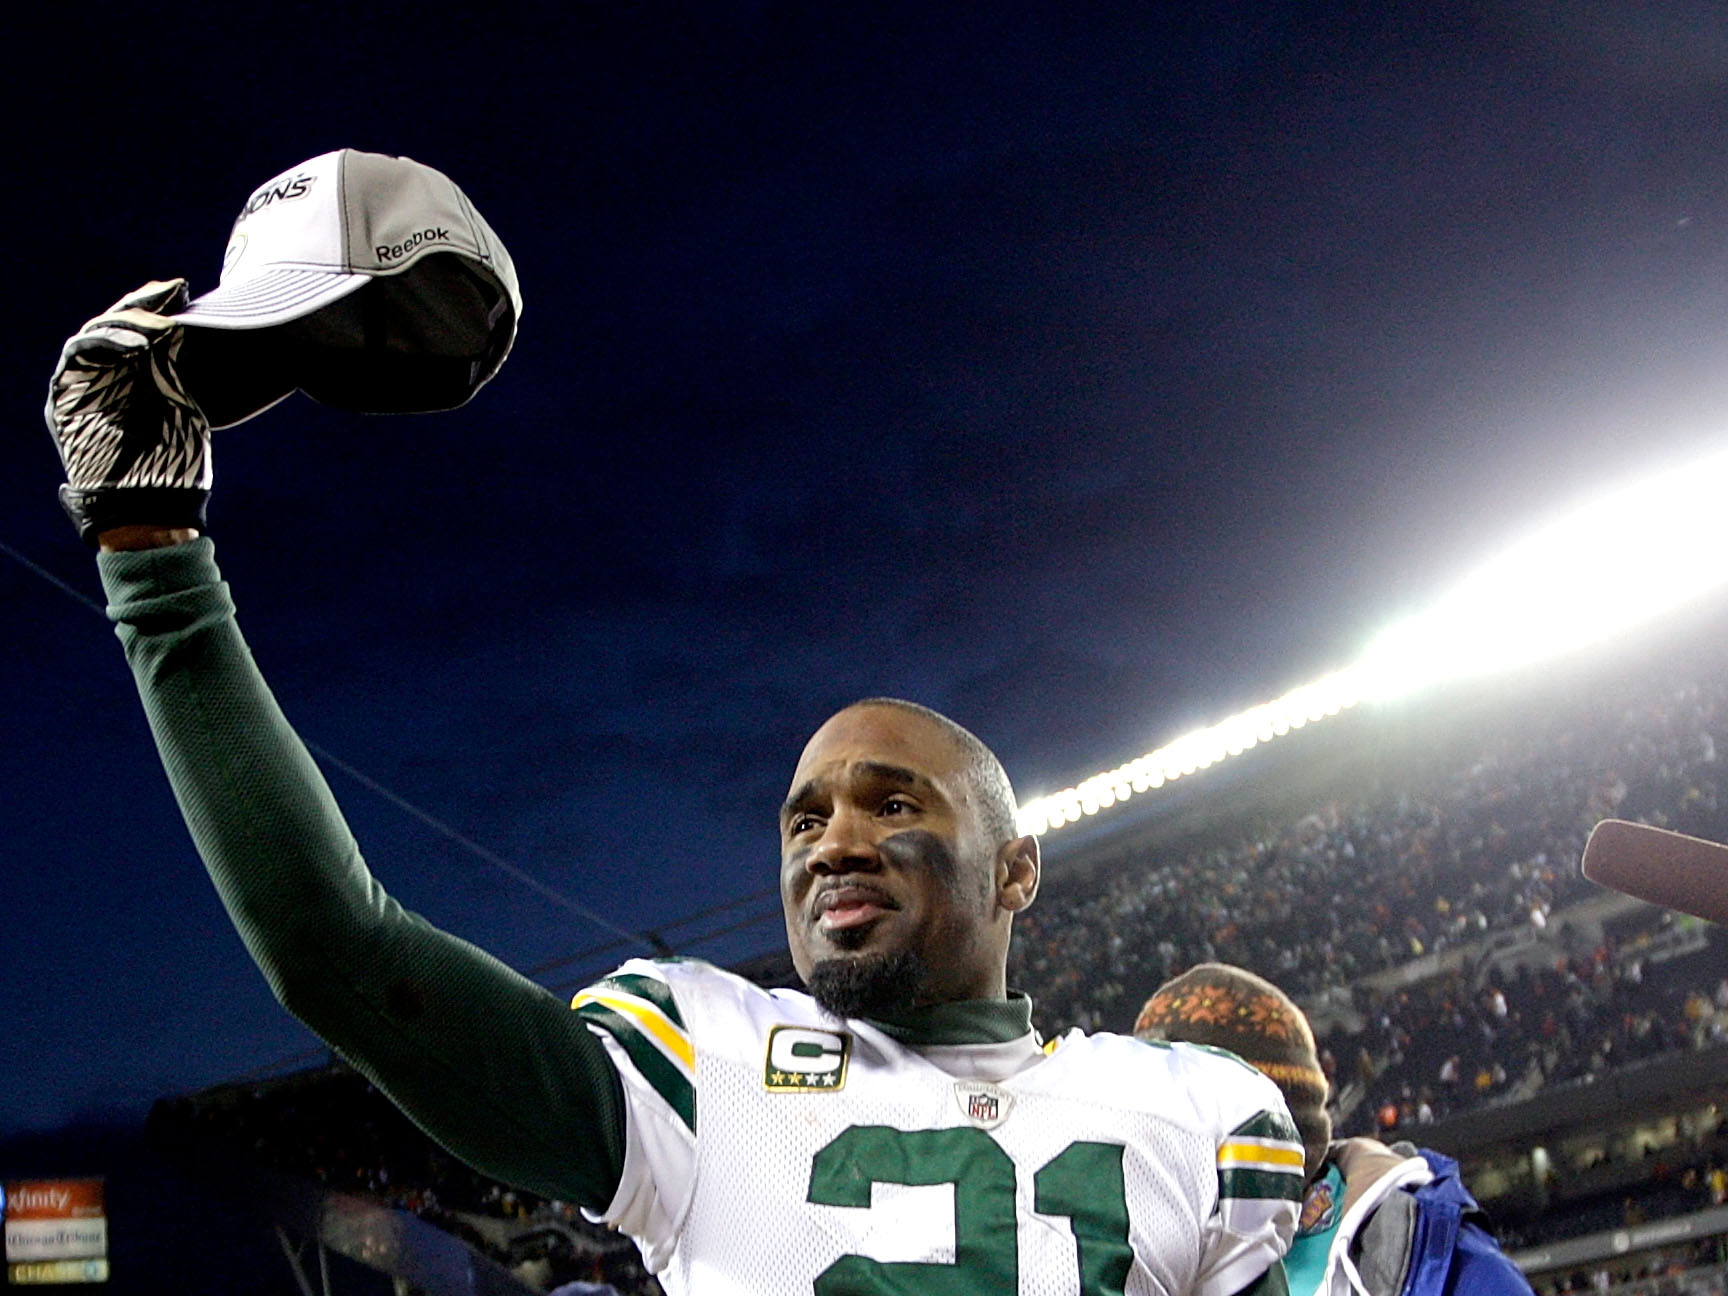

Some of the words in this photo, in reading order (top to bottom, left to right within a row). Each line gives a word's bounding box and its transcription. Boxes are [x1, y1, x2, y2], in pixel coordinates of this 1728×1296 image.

[375, 227, 450, 263] Reebok
[770, 1029, 842, 1073] C
[970, 1103, 998, 1121] NFL
